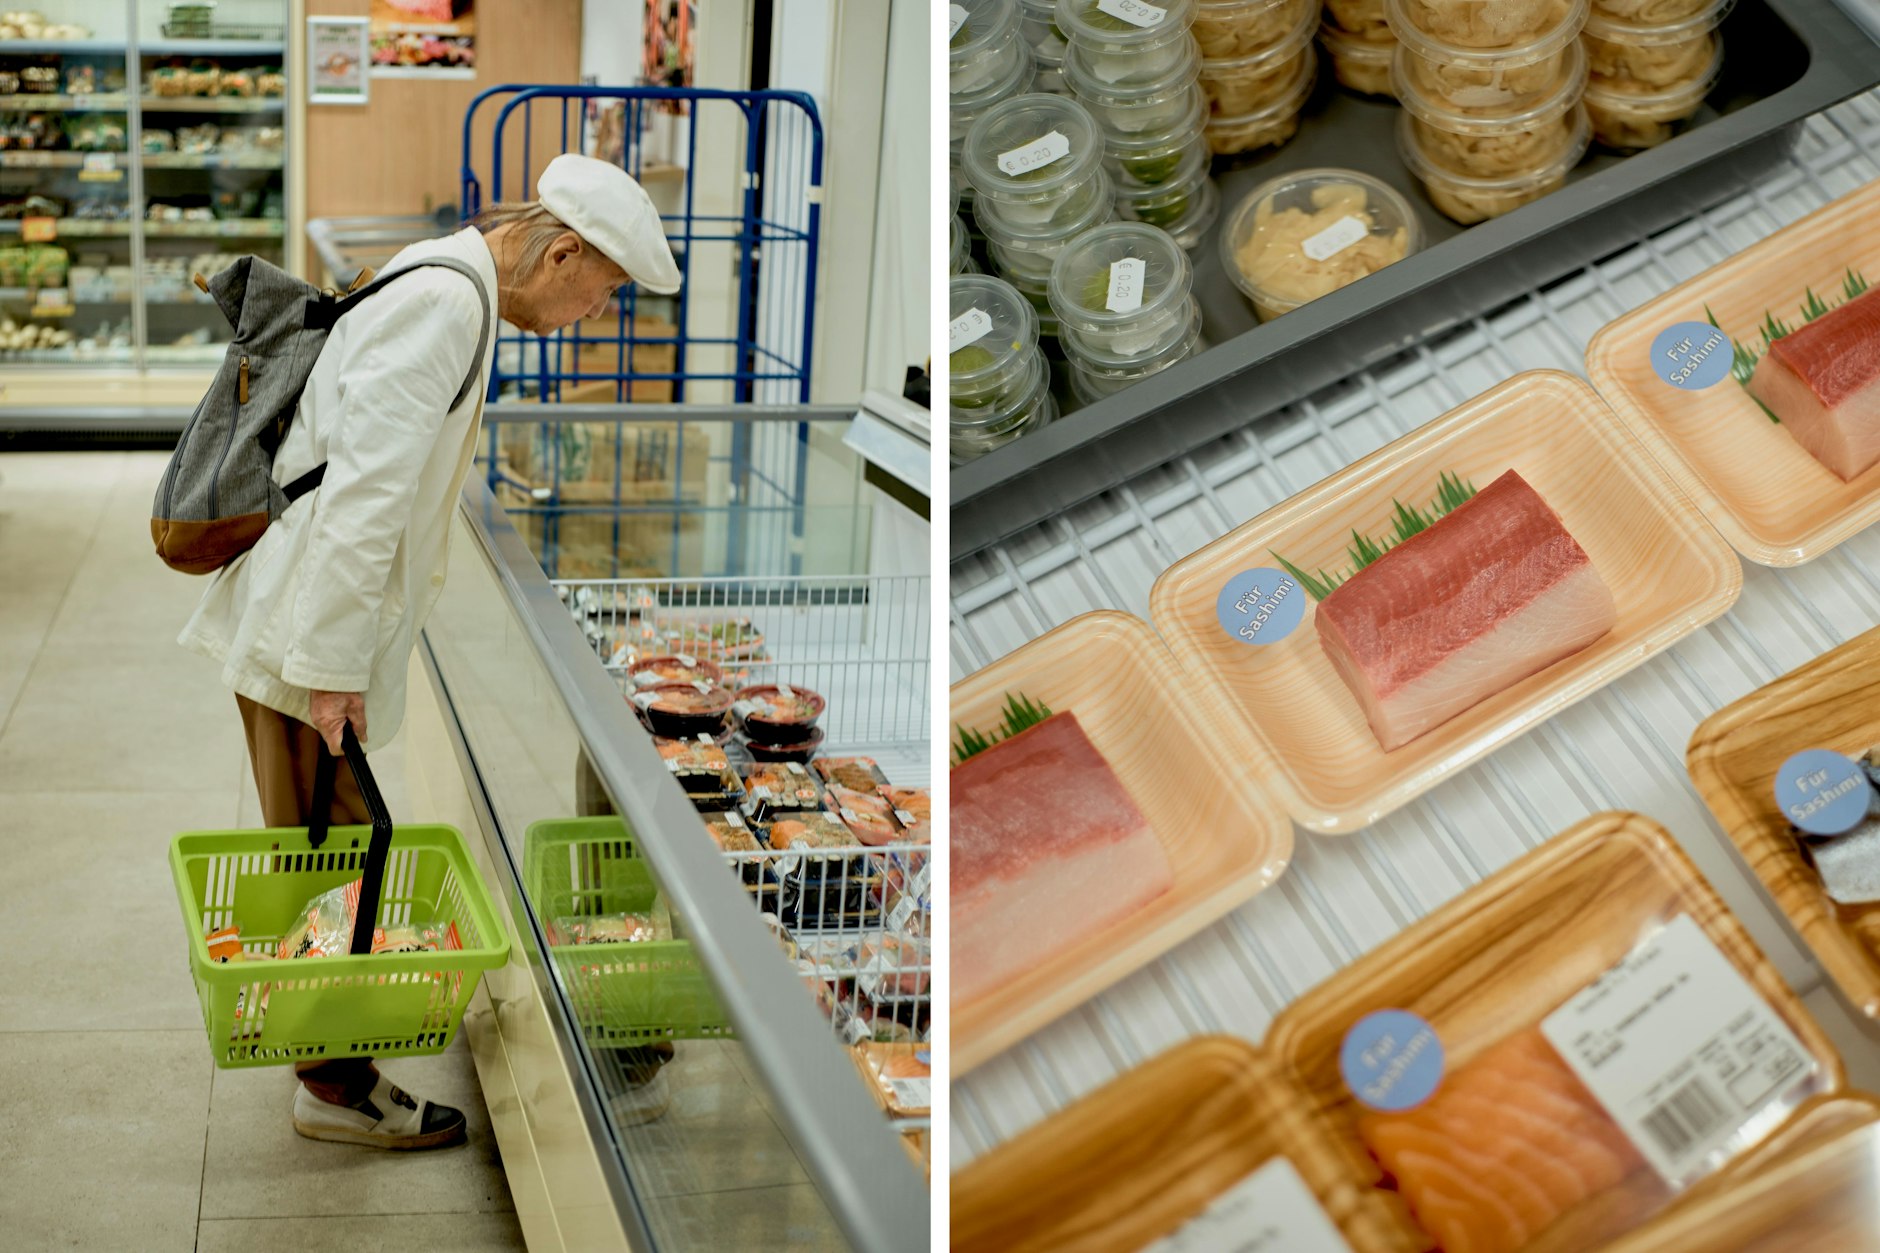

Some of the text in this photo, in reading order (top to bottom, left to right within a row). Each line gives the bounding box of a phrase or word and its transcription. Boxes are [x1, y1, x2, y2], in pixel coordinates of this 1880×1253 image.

[1119, 0, 1149, 17] 0.20
[1006, 147, 1051, 170] € 0.20
[1115, 262, 1133, 298] € 0.20
[1666, 336, 1693, 362] Für
[1669, 330, 1724, 385] Sashimi
[1234, 585, 1262, 614] Für
[1239, 577, 1295, 641] Sashimi
[1790, 771, 1863, 820] Sashimi
[1794, 766, 1829, 794] Für
[1360, 1032, 1396, 1068] Für
[1364, 1027, 1432, 1100] Sashimi
